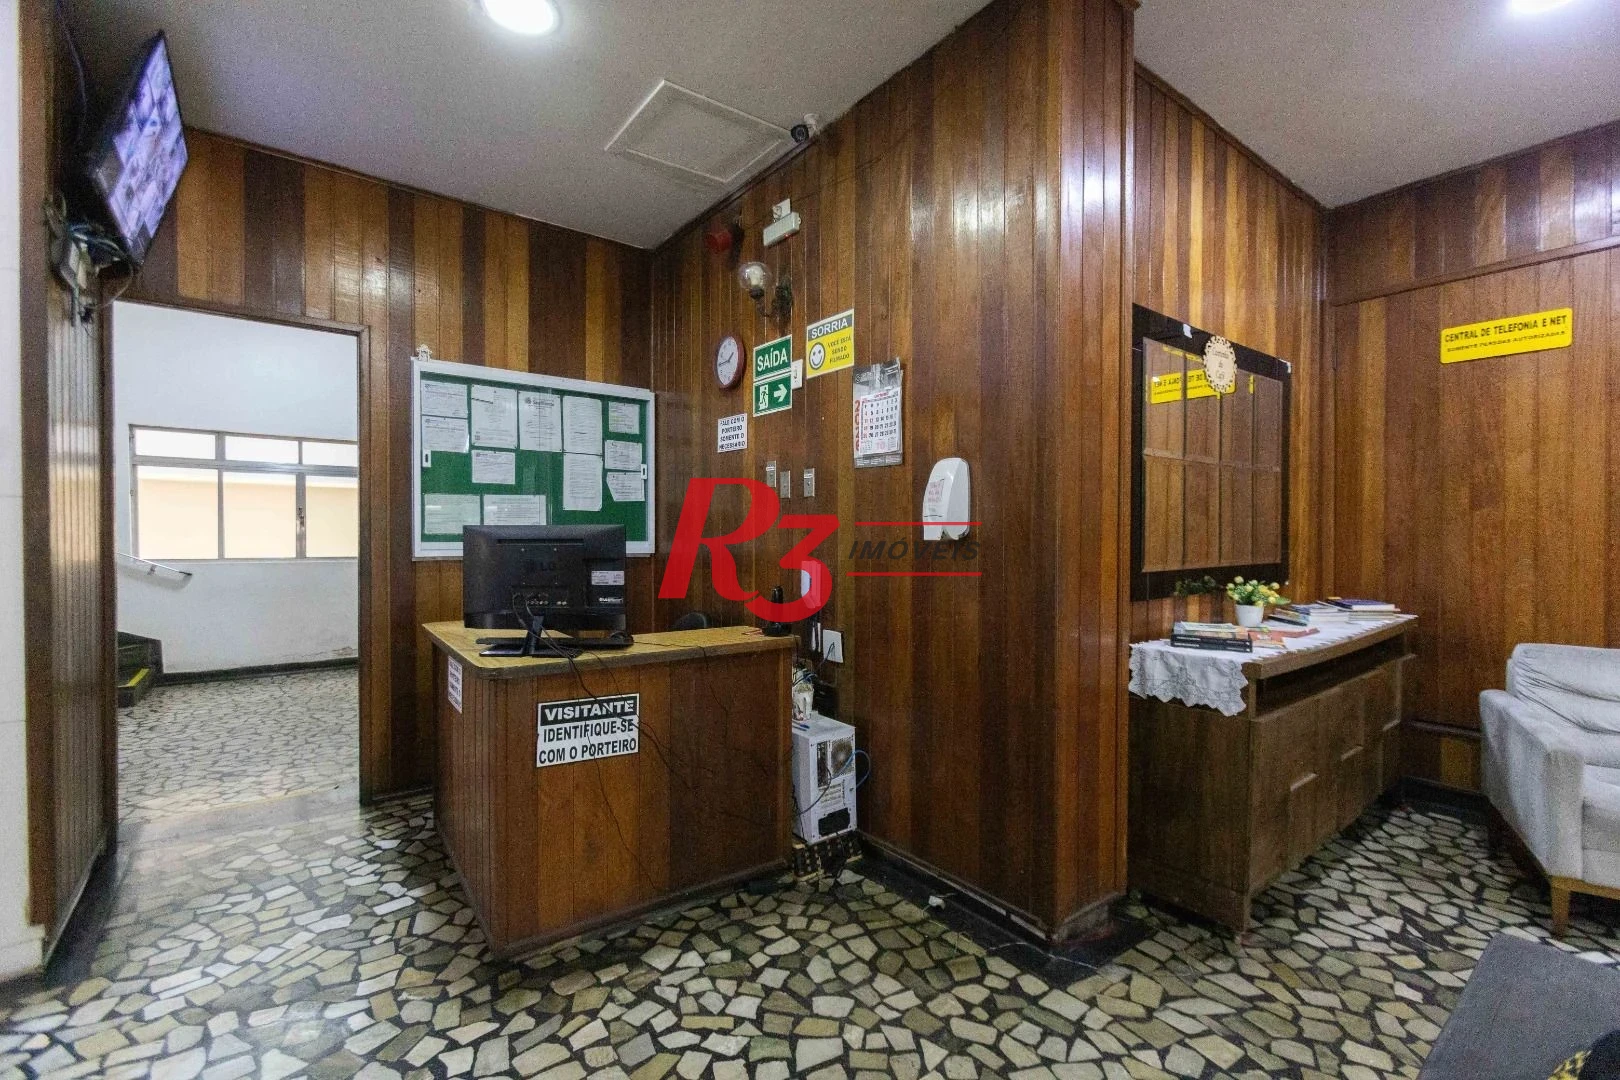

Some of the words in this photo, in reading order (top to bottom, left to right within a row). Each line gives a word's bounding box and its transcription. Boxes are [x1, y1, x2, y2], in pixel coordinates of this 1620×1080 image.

[811, 318, 848, 339] SORRIA
[1445, 330, 1478, 342] CENTRAL
[1480, 328, 1491, 337] DE
[1494, 320, 1538, 334] TELEFONIA
[1542, 318, 1547, 327] E
[1550, 315, 1567, 326] NET
[832, 345, 848, 354] SENDO
[1447, 344, 1478, 352] SOMENTE
[757, 348, 788, 372] SAÍDA
[722, 425, 742, 434] PORTEIRO
[544, 700, 634, 721] VISITANTE
[543, 719, 634, 743] IDENTIFIQUE-SE
[539, 748, 566, 764] COM
[569, 746, 578, 760] O
[581, 738, 637, 758] PORTEIRO
